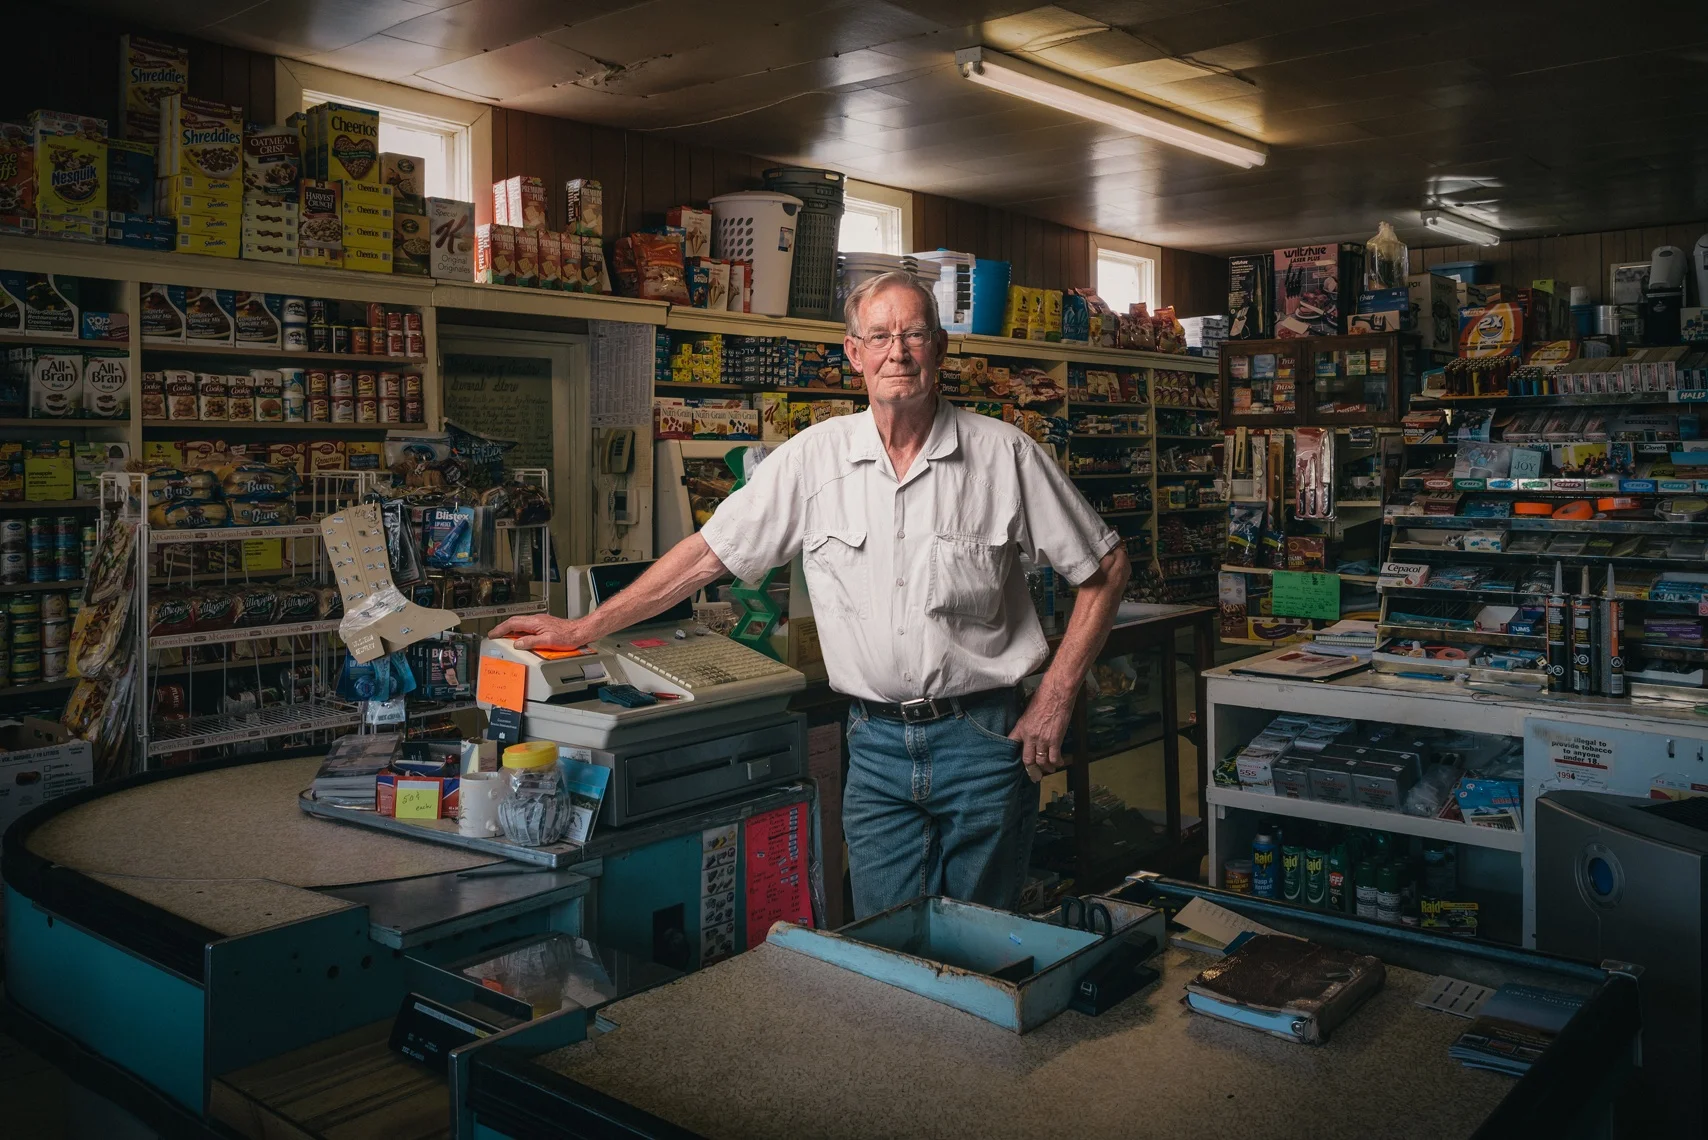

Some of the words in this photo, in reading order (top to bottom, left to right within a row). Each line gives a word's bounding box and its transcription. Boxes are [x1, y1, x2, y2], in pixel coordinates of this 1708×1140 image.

[131, 68, 186, 85] Shreddies
[331, 116, 378, 138] Cheerios
[182, 130, 241, 147] Shreddies
[250, 138, 295, 148] OATMEAL
[259, 146, 286, 157] CRISP
[52, 165, 97, 186] Nesquik
[208, 183, 230, 191] Shreddies
[357, 184, 380, 194] Cheerios
[522, 186, 544, 196] PREMIUM
[306, 192, 334, 203] HARVEST
[581, 187, 602, 198] PREMIUM
[532, 193, 545, 203] PLUS
[207, 202, 229, 210] Shreddies
[356, 206, 379, 216] Cheerios
[436, 212, 458, 221] Special
[206, 221, 227, 229] Shreddies
[356, 228, 379, 238] Cheerios
[436, 215, 469, 255] K
[491, 233, 515, 244] PREMIUM
[515, 236, 538, 246] PREMIUM
[204, 240, 226, 248] Shreddies
[503, 241, 515, 252] PLUS
[526, 243, 538, 254] PLUS
[539, 239, 561, 249] PREMIUM
[561, 242, 582, 252] PREMIUM
[356, 250, 379, 260] Cheerios
[550, 247, 561, 257] PLUS
[572, 250, 582, 260] PLUS
[582, 245, 602, 255] PREMIUM
[1284, 246, 1327, 258] wiltshire
[441, 255, 468, 267] Original
[592, 253, 603, 263] PLUS
[438, 263, 471, 275] Originales
[1359, 294, 1375, 303] Oster
[1479, 315, 1504, 330] 2X
[744, 356, 756, 364] 25
[41, 370, 73, 383] Bran
[92, 372, 123, 385] Bran
[744, 375, 756, 383] 25
[172, 384, 192, 393] Cookie
[206, 383, 225, 392] Cookie
[231, 387, 251, 395] Cookie
[260, 385, 280, 394] Muffin
[1275, 384, 1296, 392] TYLENO
[1680, 391, 1706, 400] HALLS
[1275, 404, 1296, 412] TYLENO
[314, 454, 342, 467] Brownies
[1514, 461, 1536, 472] JOY
[247, 480, 275, 493] Buns
[1429, 480, 1451, 488] CERTS
[1460, 480, 1481, 488] CERTS
[163, 485, 192, 500] Buns
[1431, 491, 1456, 500] JOY
[252, 508, 279, 524] Buns
[435, 510, 470, 523] Blistex
[1512, 625, 1531, 633] TUMS
[1573, 737, 1598, 747] illegal
[1551, 741, 1579, 750] provide
[1581, 744, 1612, 755] tobacco
[1573, 749, 1601, 759] anyone
[1563, 754, 1585, 763] under
[1587, 757, 1600, 765] 18.
[1239, 768, 1257, 777] 555
[1254, 851, 1273, 865] Raid
[1253, 878, 1268, 886] Wasp
[1421, 900, 1441, 914] Raid
[1505, 988, 1536, 1000] GREAT
